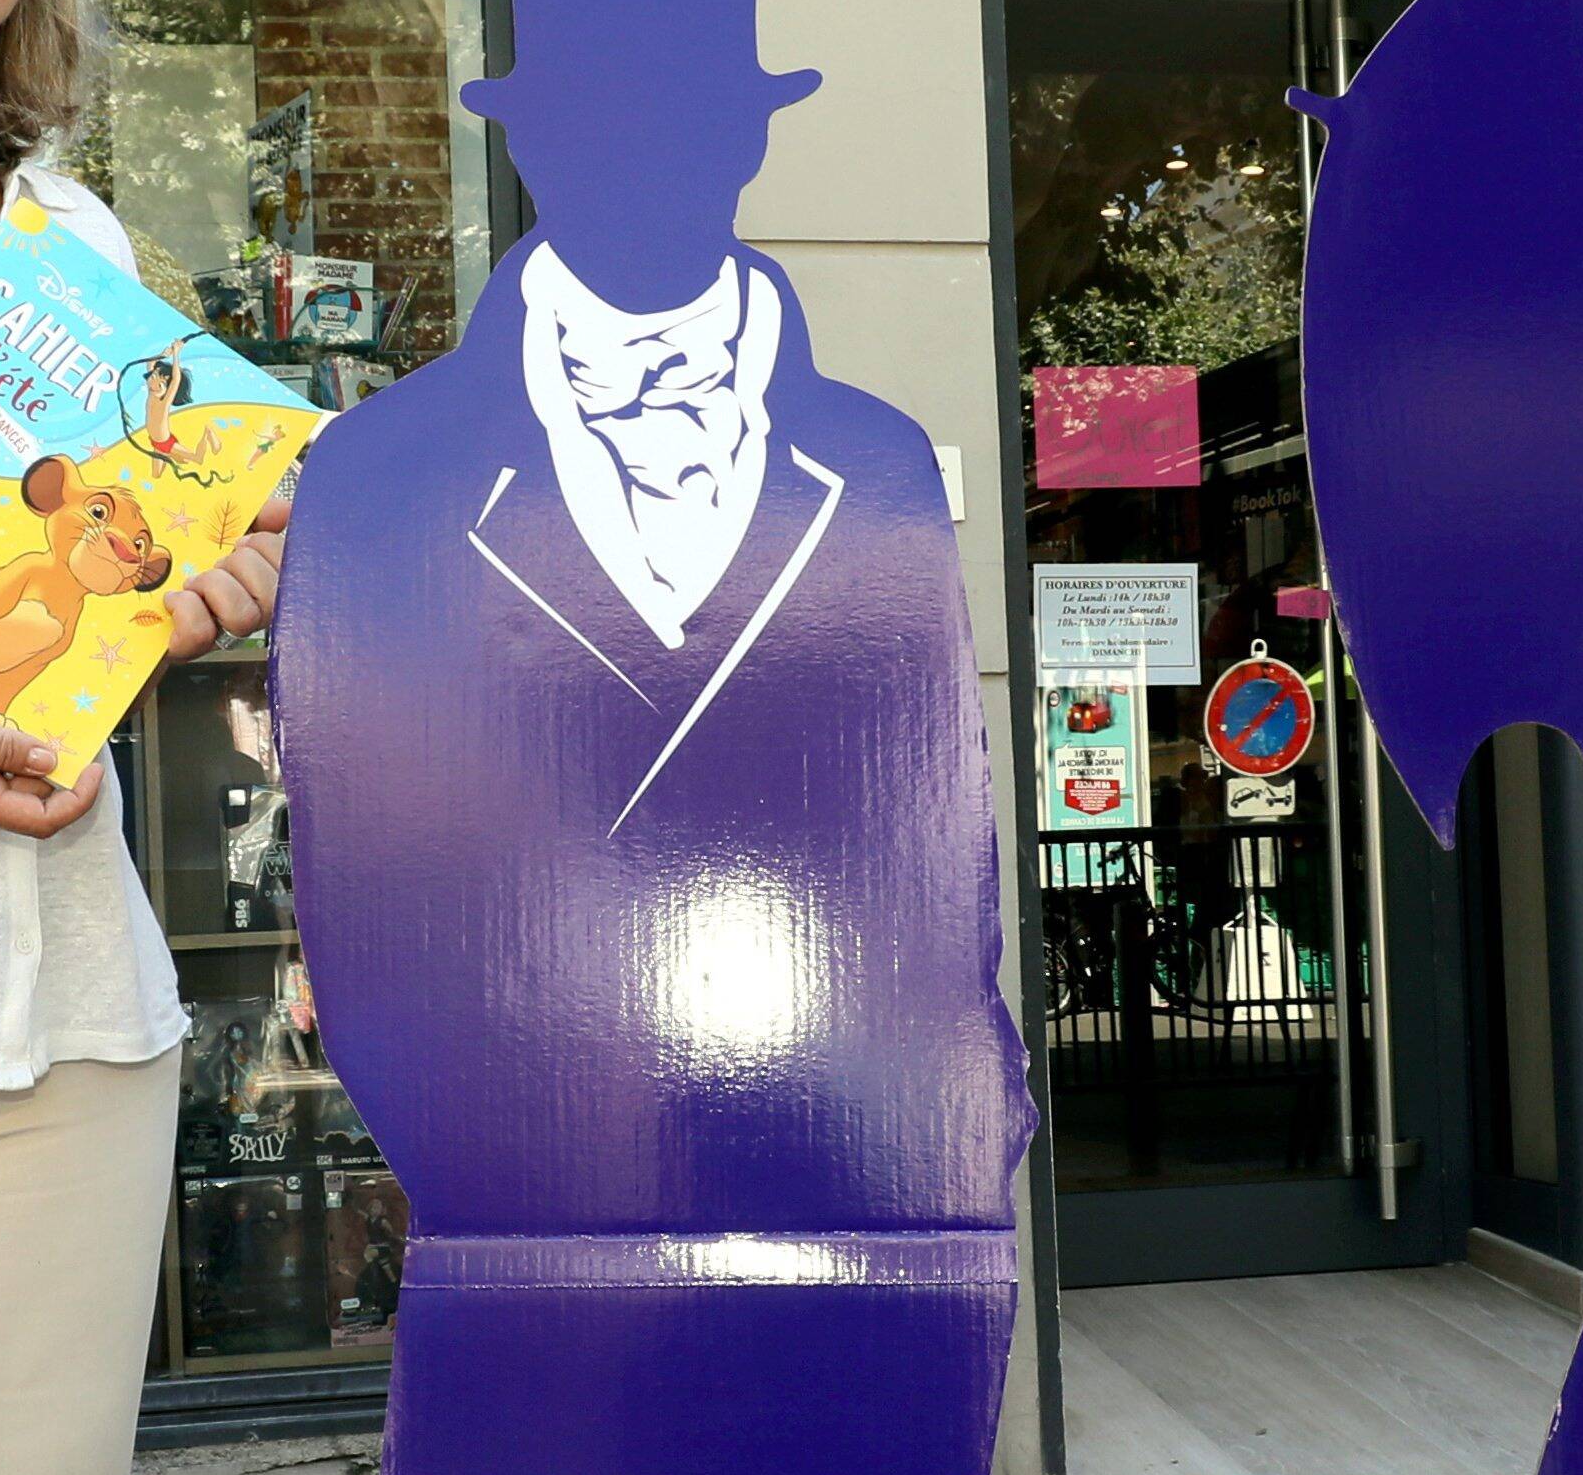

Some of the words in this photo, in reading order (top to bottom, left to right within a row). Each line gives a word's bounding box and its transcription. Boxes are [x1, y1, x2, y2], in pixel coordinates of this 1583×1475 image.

[314, 261, 358, 273] MONSIEUR
[318, 269, 355, 279] MADAME
[36, 260, 114, 339] Disney
[1232, 484, 1303, 513] #BookTok
[1045, 580, 1103, 589] HORAIRES
[1105, 580, 1187, 589] D'OUVERTURE
[1077, 593, 1108, 602] Lundi
[1079, 605, 1111, 614] Mardi
[1092, 648, 1141, 656] DIMANCH
